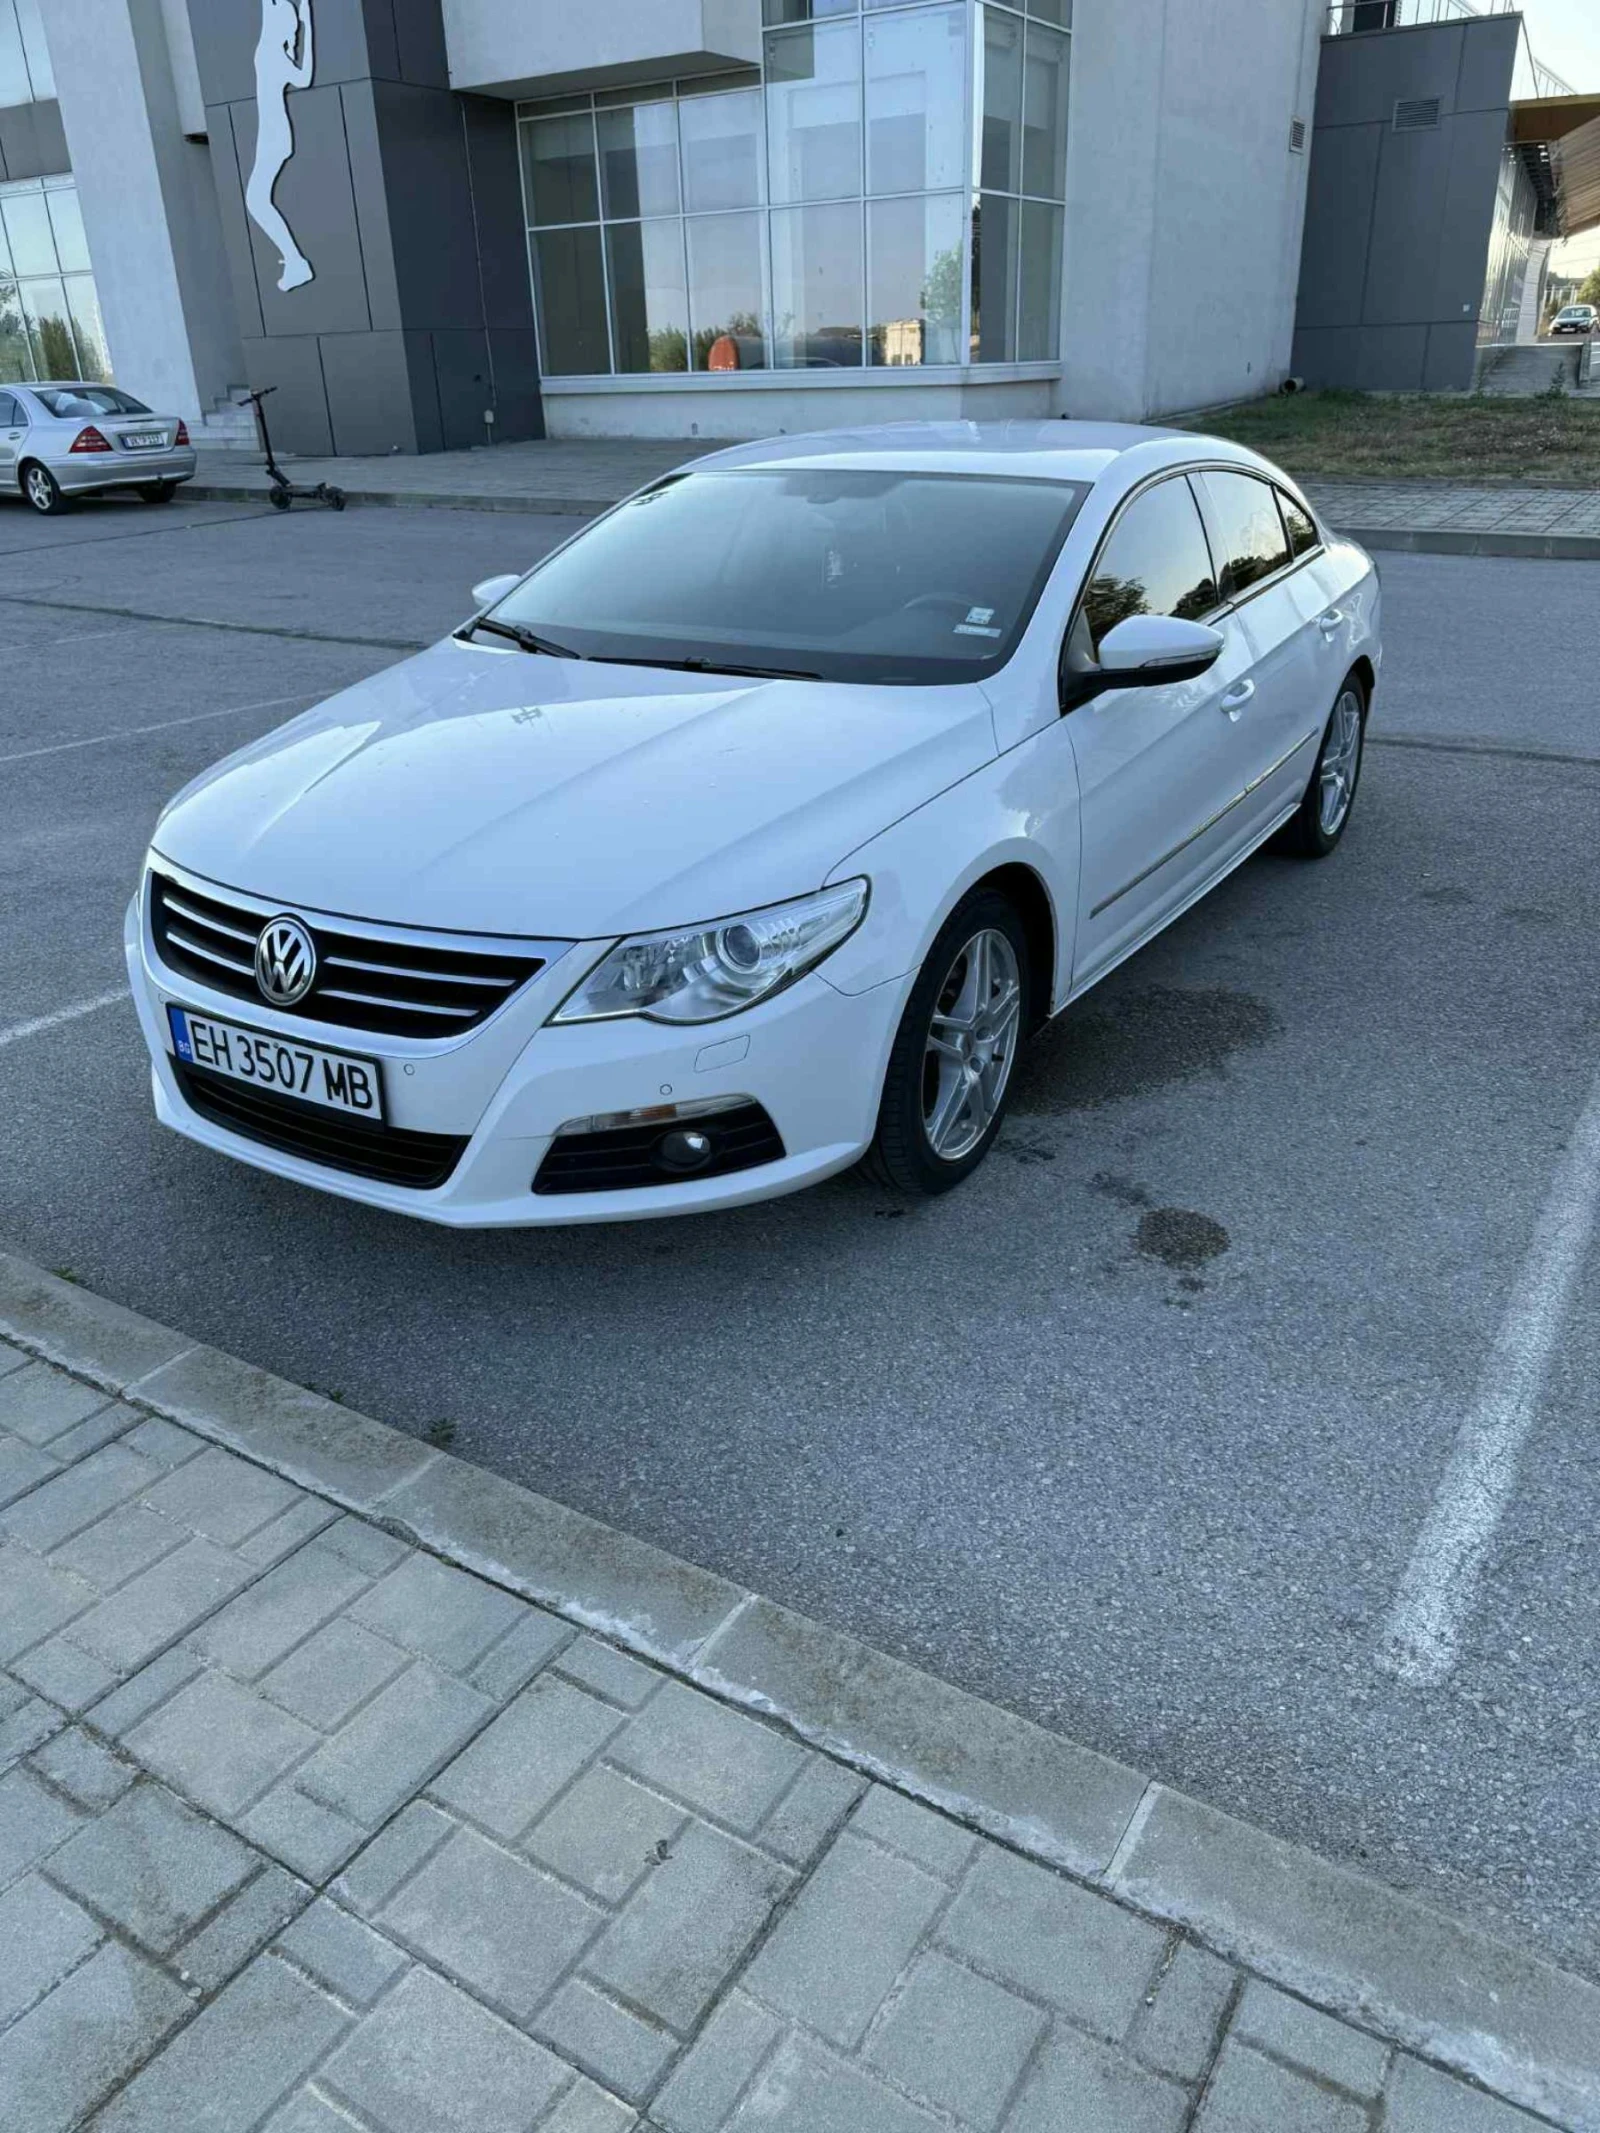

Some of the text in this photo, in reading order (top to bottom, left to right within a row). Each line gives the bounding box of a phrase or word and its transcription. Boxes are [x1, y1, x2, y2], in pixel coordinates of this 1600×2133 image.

[178, 1039, 191, 1054] BG
[190, 1020, 373, 1110] EH 3507 MB
